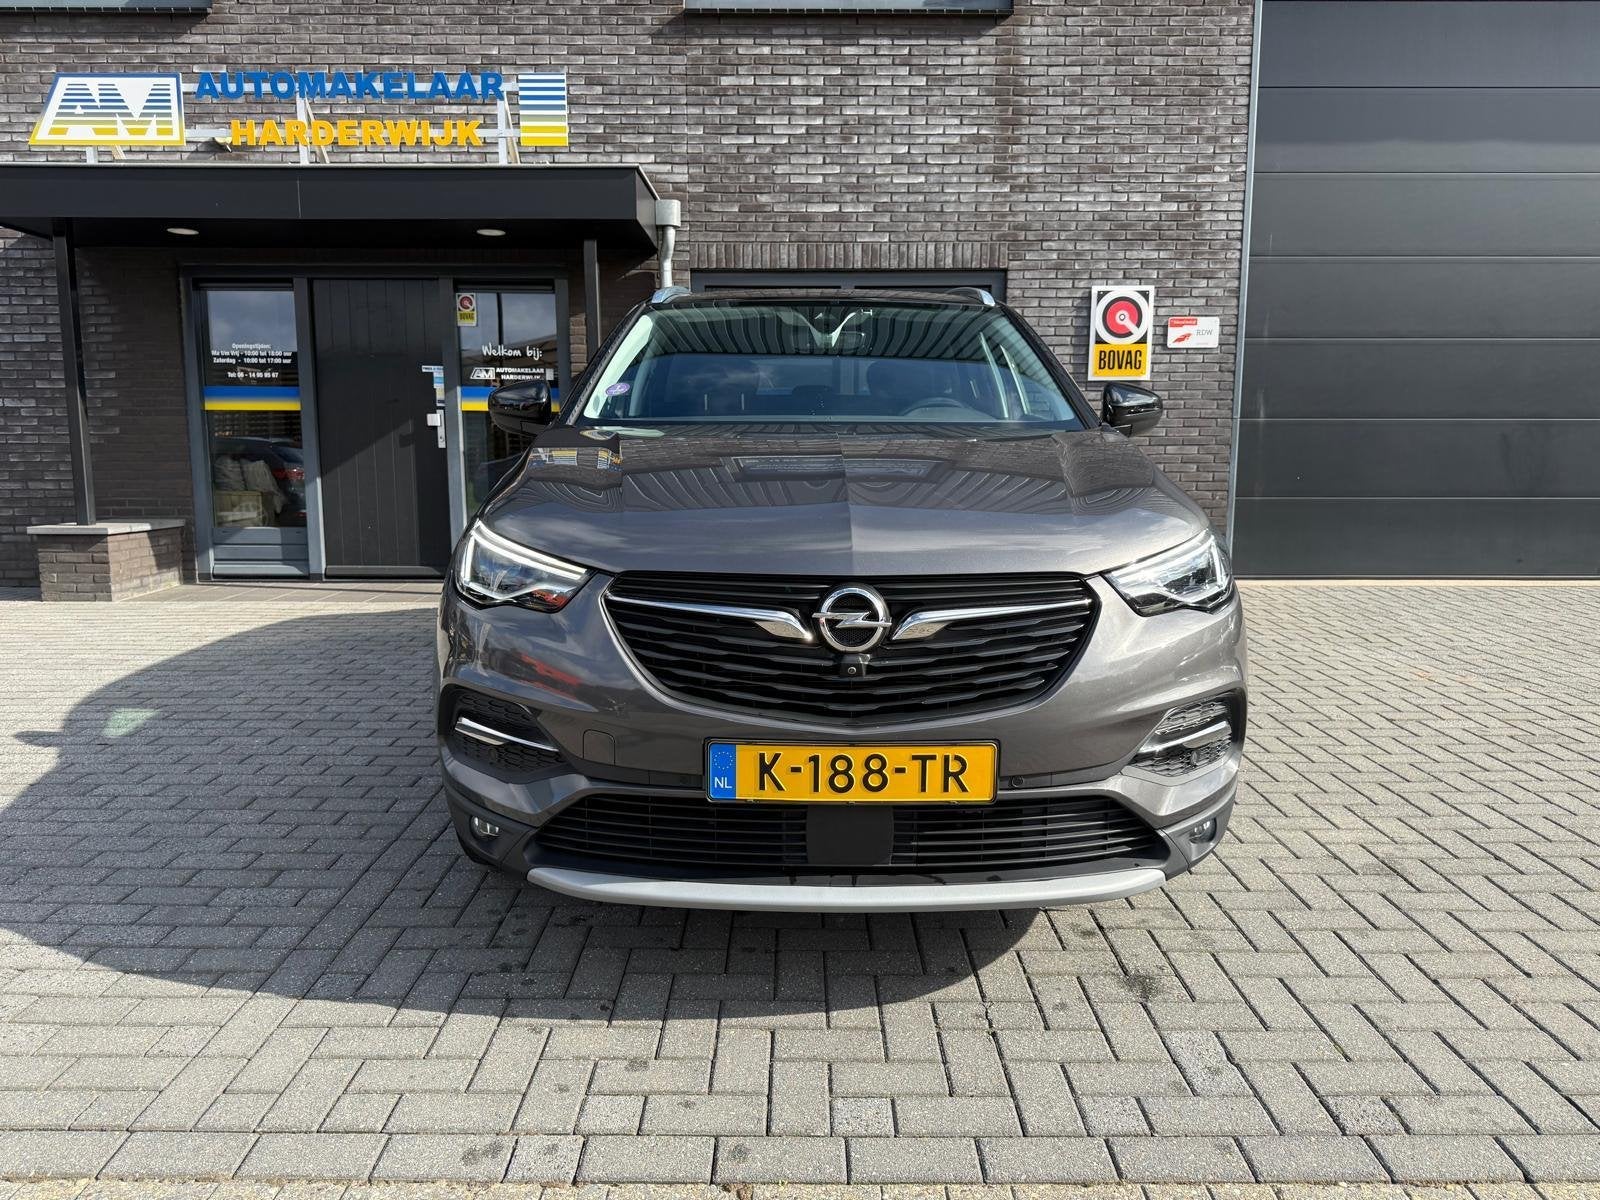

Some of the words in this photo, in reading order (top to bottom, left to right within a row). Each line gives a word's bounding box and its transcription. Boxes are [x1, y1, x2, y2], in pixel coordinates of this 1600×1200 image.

[195, 71, 505, 100] AUTOMAKELAAR
[47, 83, 172, 136] AM
[230, 119, 483, 146] HARDERWIJK
[481, 342, 522, 357] Welkom
[526, 345, 543, 361] bij:
[1098, 349, 1142, 370] BOVAG
[474, 368, 493, 379] AM
[714, 777, 732, 789] NL
[757, 752, 969, 793] K-188-TR
